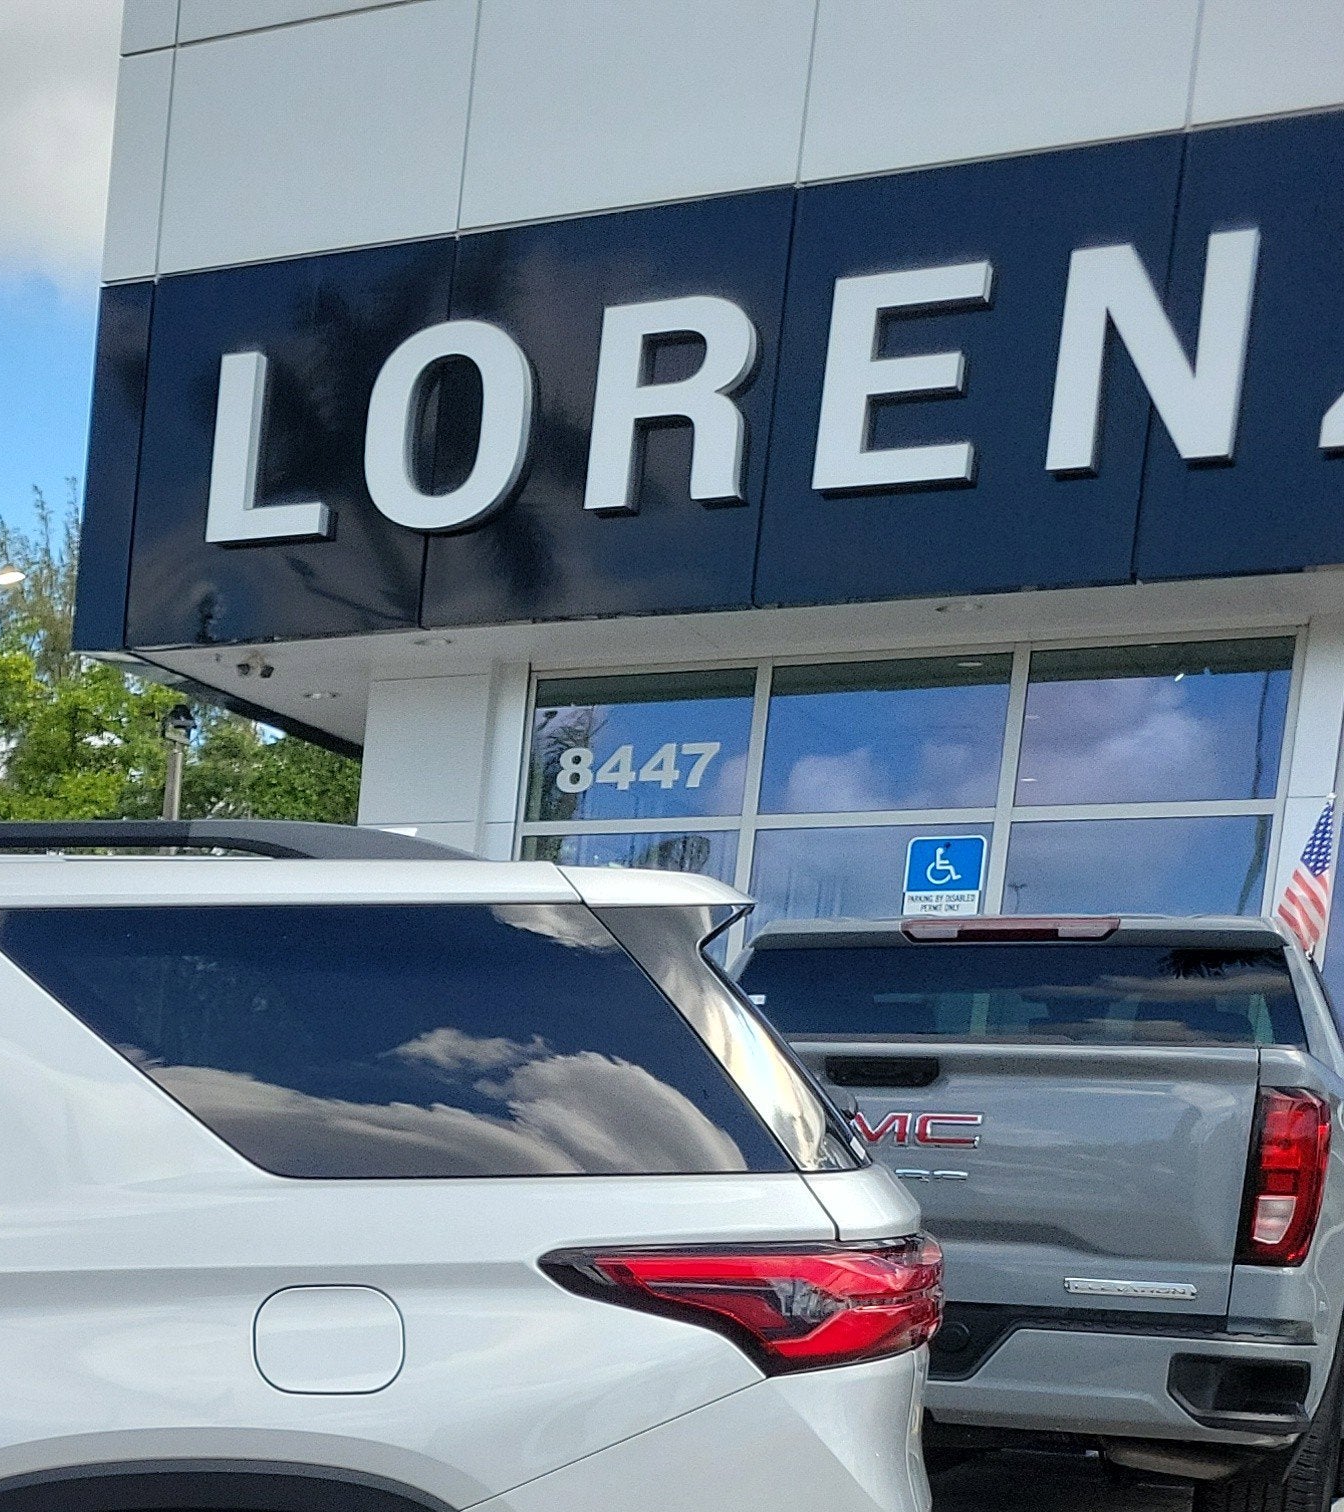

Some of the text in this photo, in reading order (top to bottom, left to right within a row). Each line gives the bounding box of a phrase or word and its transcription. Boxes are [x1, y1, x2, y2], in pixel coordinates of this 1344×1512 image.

[205, 228, 1343, 545] LOREN
[556, 742, 721, 793] 8447
[850, 1112, 983, 1149] MC
